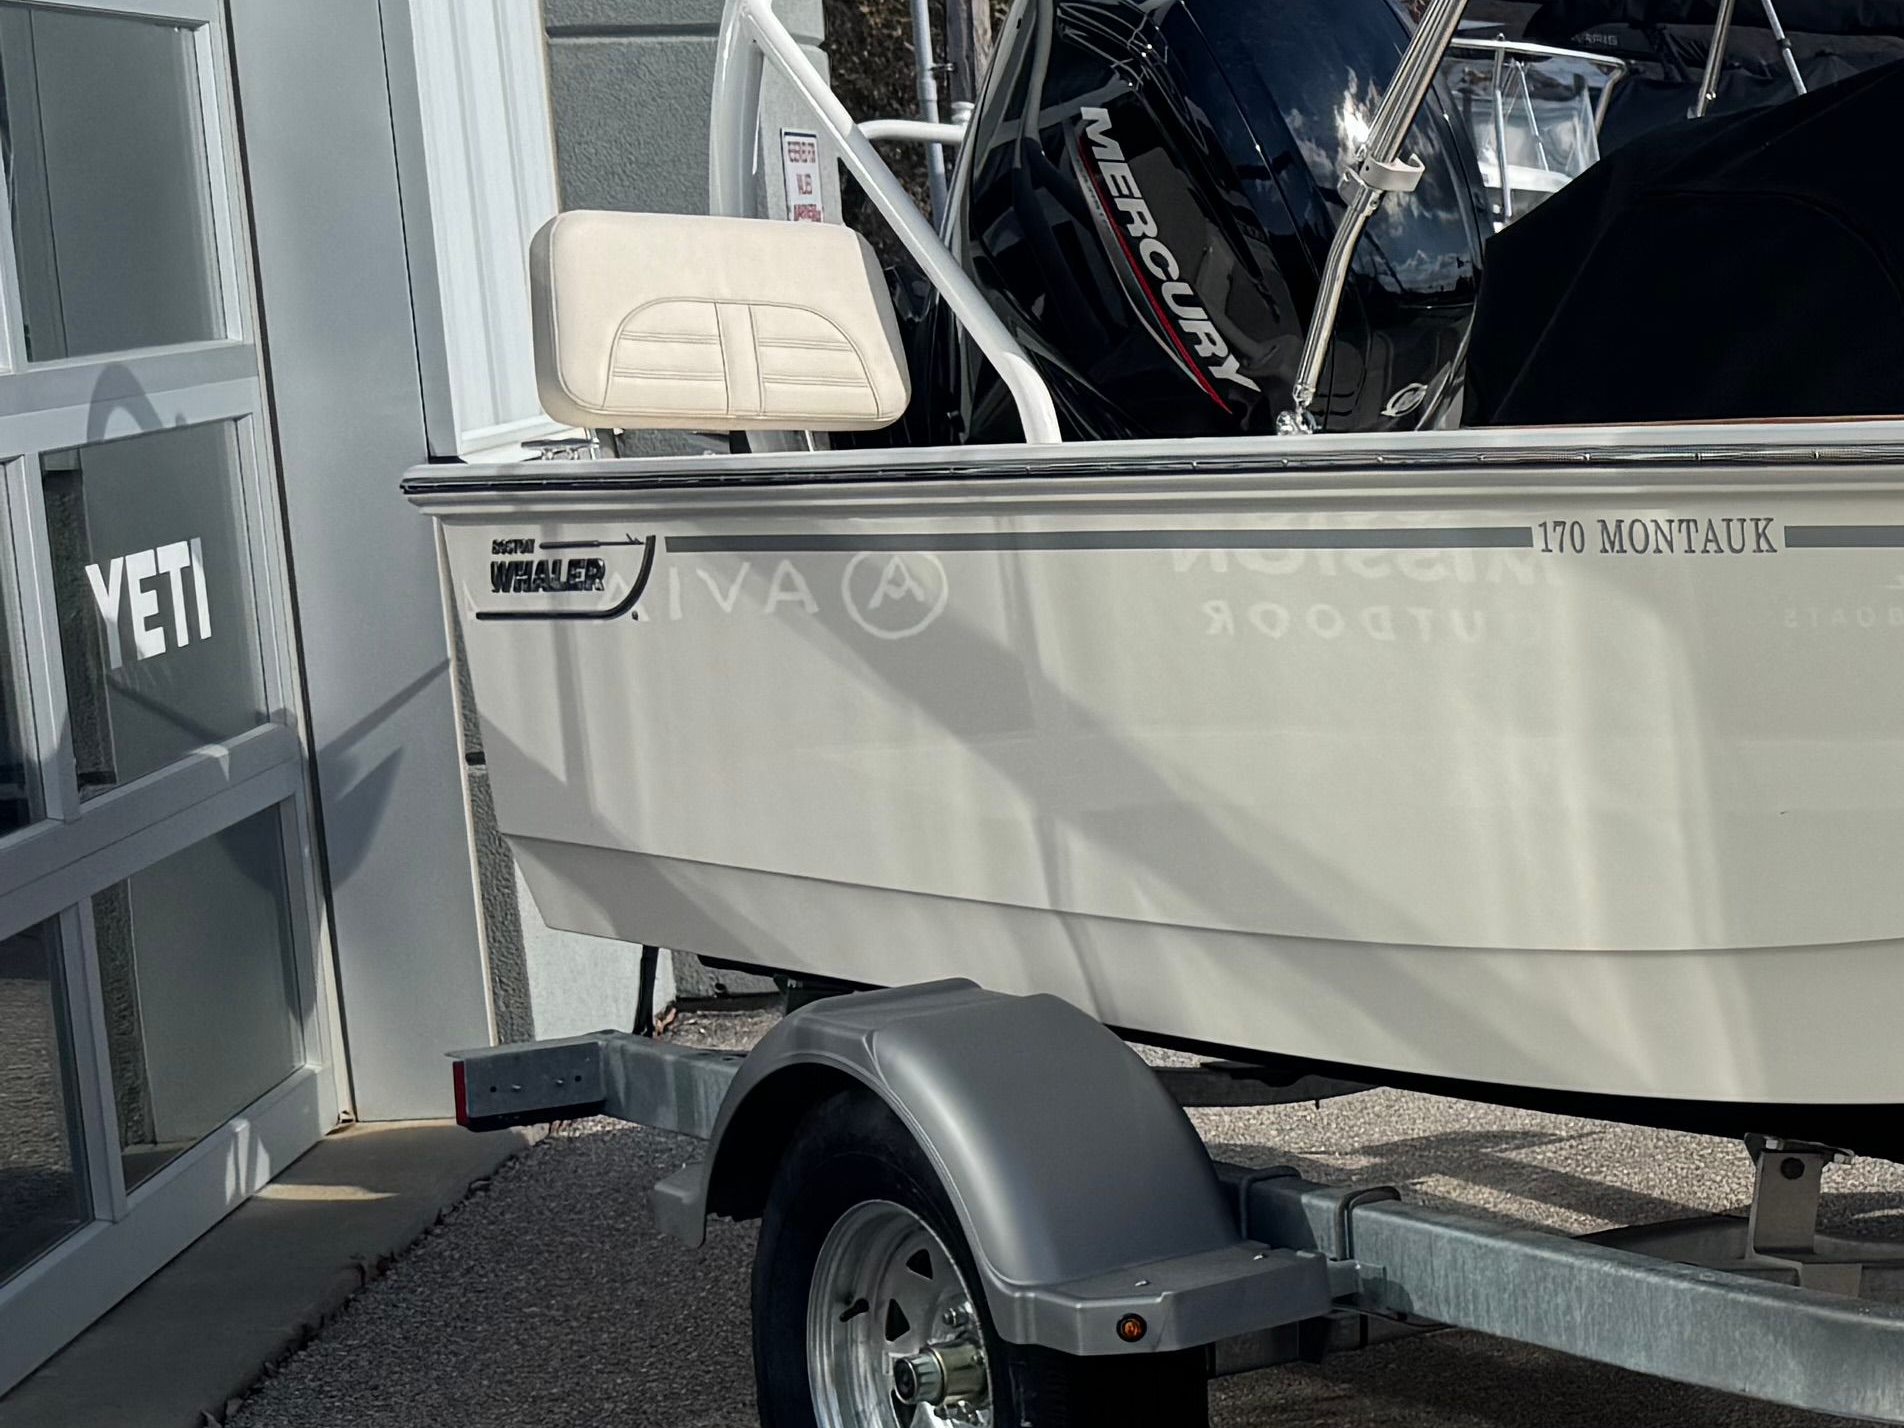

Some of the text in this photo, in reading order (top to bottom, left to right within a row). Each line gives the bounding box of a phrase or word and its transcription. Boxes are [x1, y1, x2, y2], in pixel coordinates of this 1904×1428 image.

[1080, 106, 1261, 392] MERCURY
[490, 558, 606, 593] WHALER
[1538, 517, 1778, 554] 170 MONTAUK
[85, 537, 212, 670] YETI
